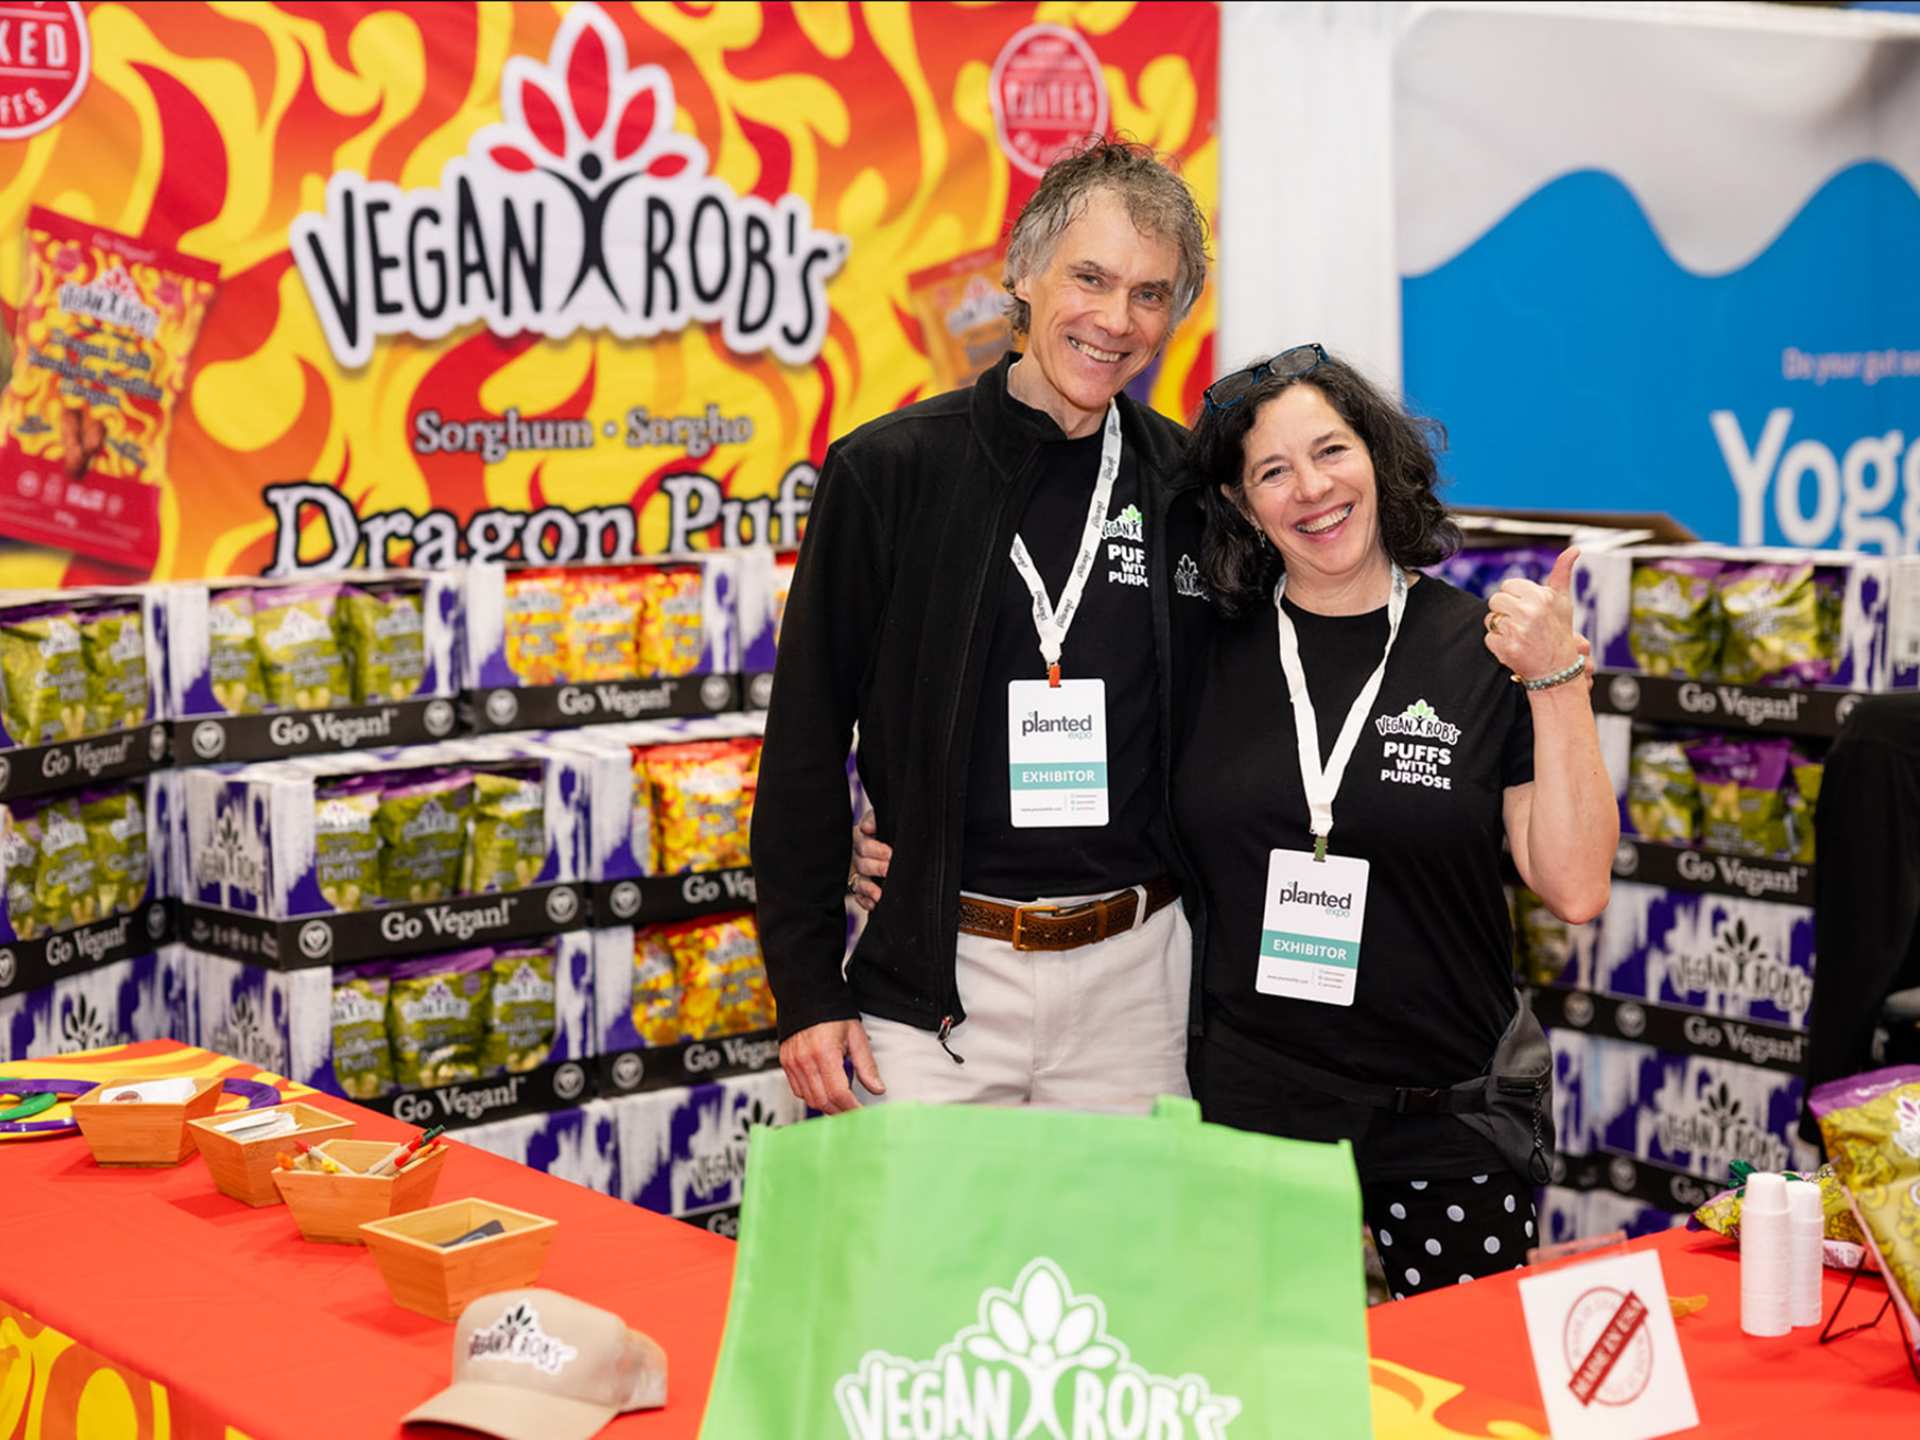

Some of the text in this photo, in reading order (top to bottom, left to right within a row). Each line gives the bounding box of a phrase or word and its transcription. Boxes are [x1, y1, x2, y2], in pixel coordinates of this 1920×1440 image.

[306, 175, 829, 348] VEGAN ROB'S
[414, 402, 754, 464] Sorghum Sorgho
[1709, 407, 1920, 554] Yog
[262, 481, 639, 574] Dragon
[1108, 544, 1145, 563] PUF
[1121, 561, 1146, 576] WIT
[557, 686, 595, 715] Go
[1678, 682, 1717, 713] Go
[269, 708, 390, 748] Go Vegan!
[1022, 710, 1092, 736] planted
[1377, 715, 1458, 744] VEGAN ROB'S
[43, 748, 70, 778] Go
[1383, 741, 1452, 766] PUFFS
[1396, 759, 1437, 775] WITH
[1022, 769, 1095, 783] EXHIBITOR
[1380, 768, 1452, 790] PURPOSE
[1677, 851, 1797, 896] Go Vegan!
[682, 874, 720, 904] Go
[1279, 880, 1353, 910] planted
[381, 898, 510, 941] Go Vegan!
[46, 936, 73, 966] Go
[1272, 939, 1348, 961] EXHIBITOR
[1672, 952, 1732, 994] VEGAN
[1684, 1016, 1801, 1064] Go Vegan!
[684, 1044, 721, 1073] Go
[393, 1077, 518, 1122] Go Vegan!
[846, 1354, 1012, 1440] VEGAN
